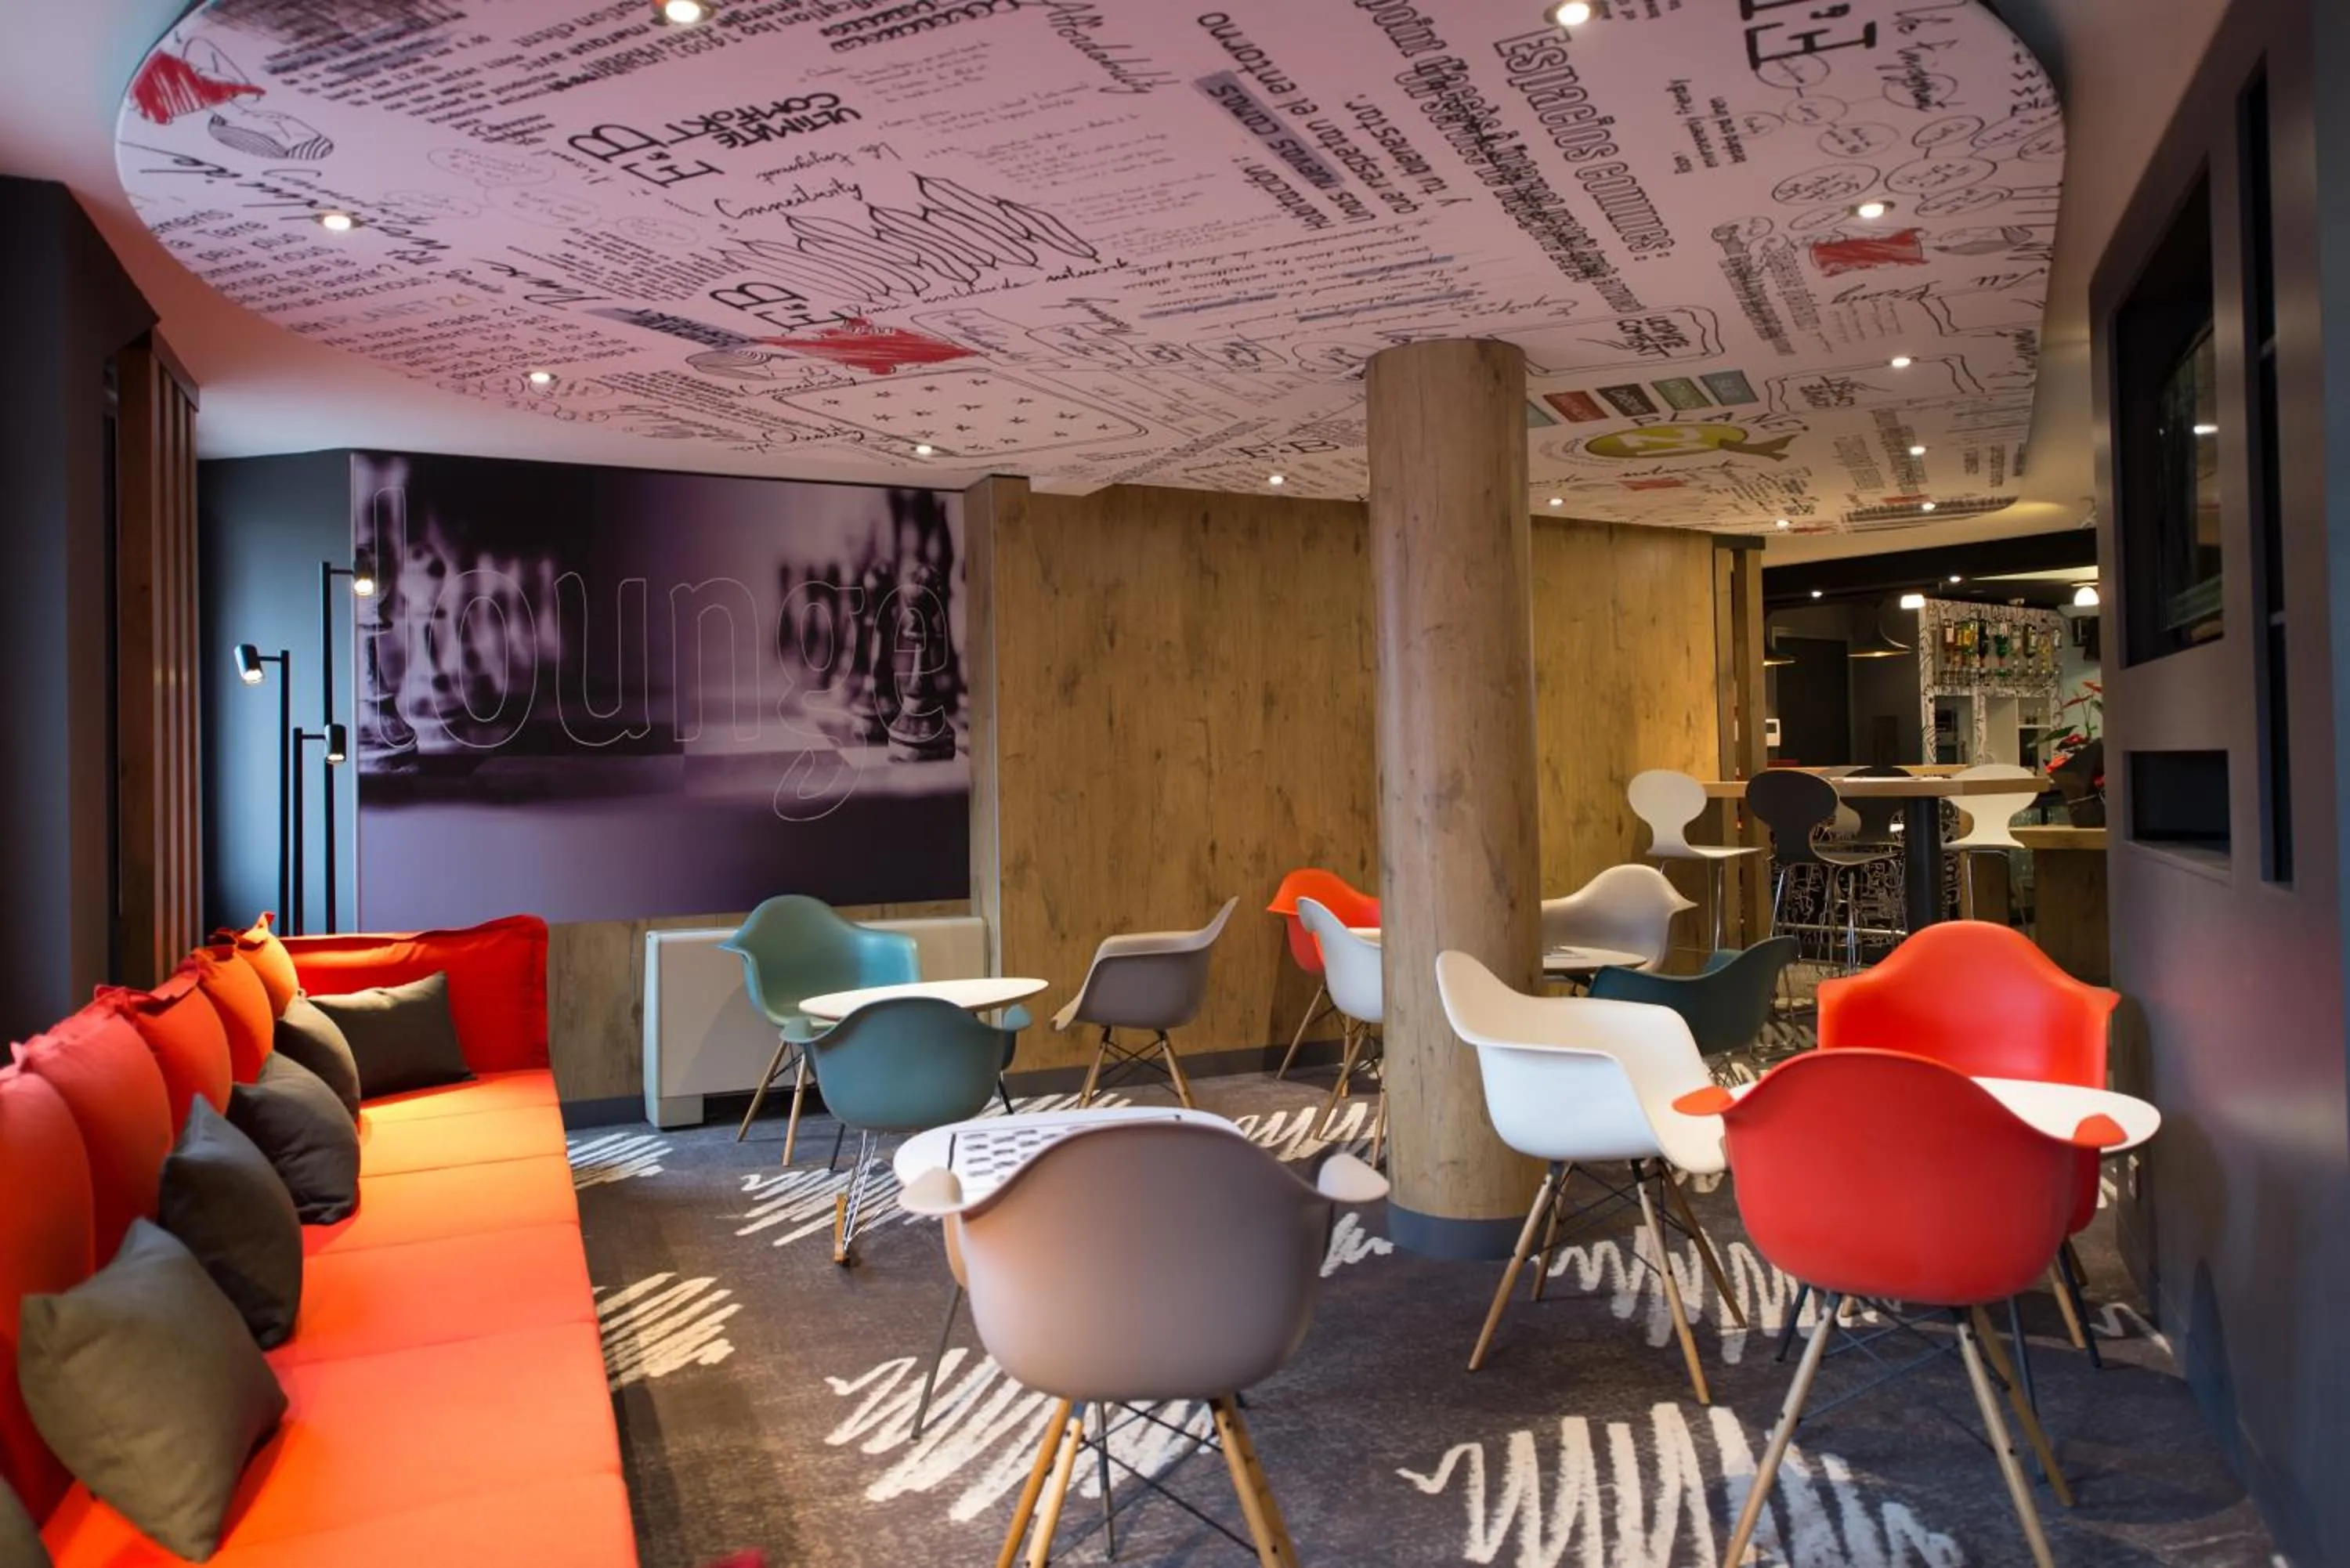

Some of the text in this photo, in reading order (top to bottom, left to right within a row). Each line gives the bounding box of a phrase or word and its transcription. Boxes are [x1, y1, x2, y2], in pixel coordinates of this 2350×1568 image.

[668, 93, 839, 143] COMFORT
[715, 105, 859, 147] ULTIMATE
[1198, 13, 1422, 213] que respetan el entorno
[1207, 84, 1376, 222] Unas nuevas camas
[1347, 96, 1472, 207] y tu bienestar.
[1497, 26, 1616, 161] Espacios
[1577, 163, 1672, 251] comunes
[194, 222, 267, 238] Terre
[715, 179, 862, 219] Connectivity
[1245, 166, 1332, 229] Habitación
[374, 486, 949, 822] lounge
